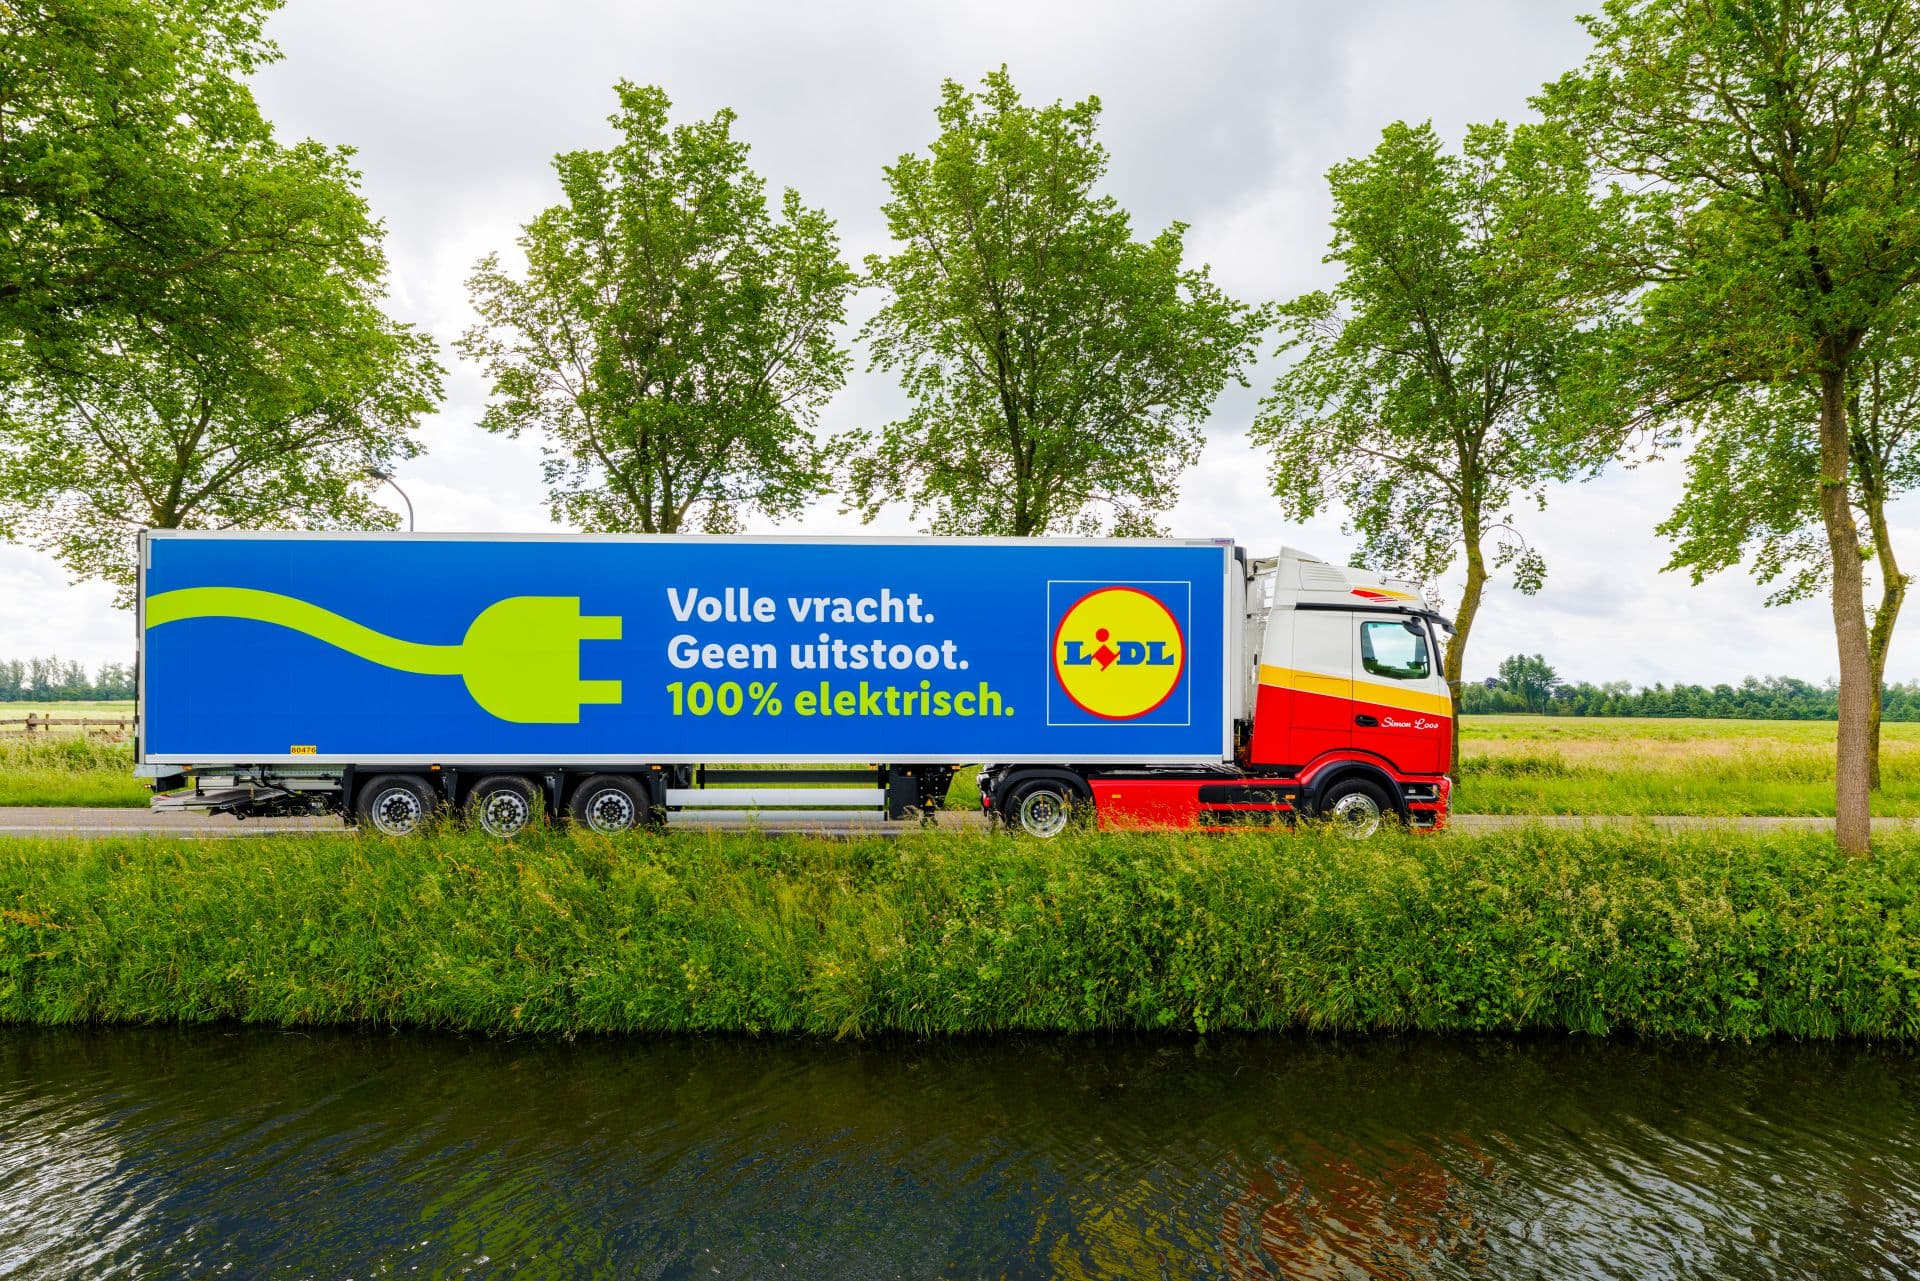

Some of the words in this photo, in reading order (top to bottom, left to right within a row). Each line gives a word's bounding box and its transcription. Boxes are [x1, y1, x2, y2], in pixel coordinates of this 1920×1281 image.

[667, 587, 776, 622] Volle
[788, 588, 935, 623] vracht.
[667, 634, 777, 669] Geen
[790, 633, 969, 670] uitstoot.
[666, 681, 783, 716] 100%
[794, 680, 1015, 717] elektrisch.
[1381, 717, 1411, 728] Simon
[1414, 718, 1439, 730] Loos
